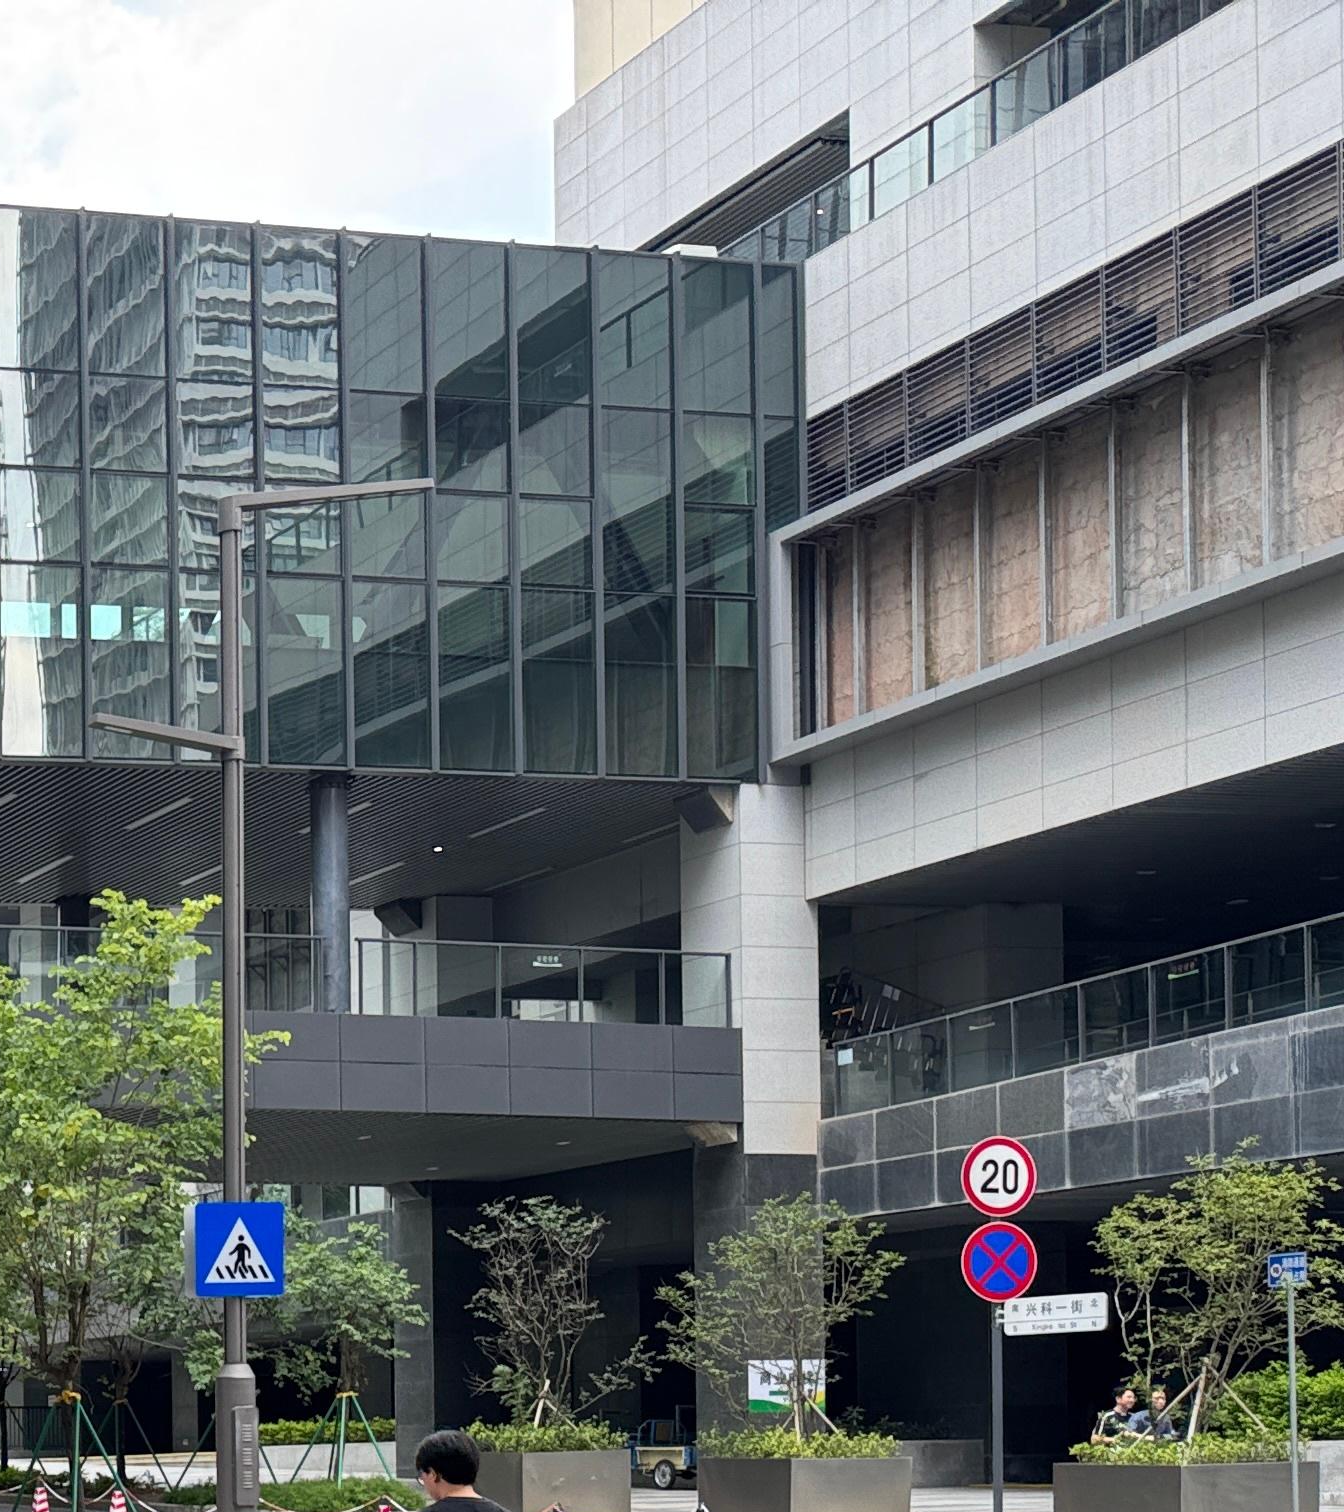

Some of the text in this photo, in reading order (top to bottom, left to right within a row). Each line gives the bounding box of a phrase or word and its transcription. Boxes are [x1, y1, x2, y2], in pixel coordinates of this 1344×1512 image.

[980, 1159, 1019, 1195] 20
[1026, 1299, 1083, 1317] 兴科一街
